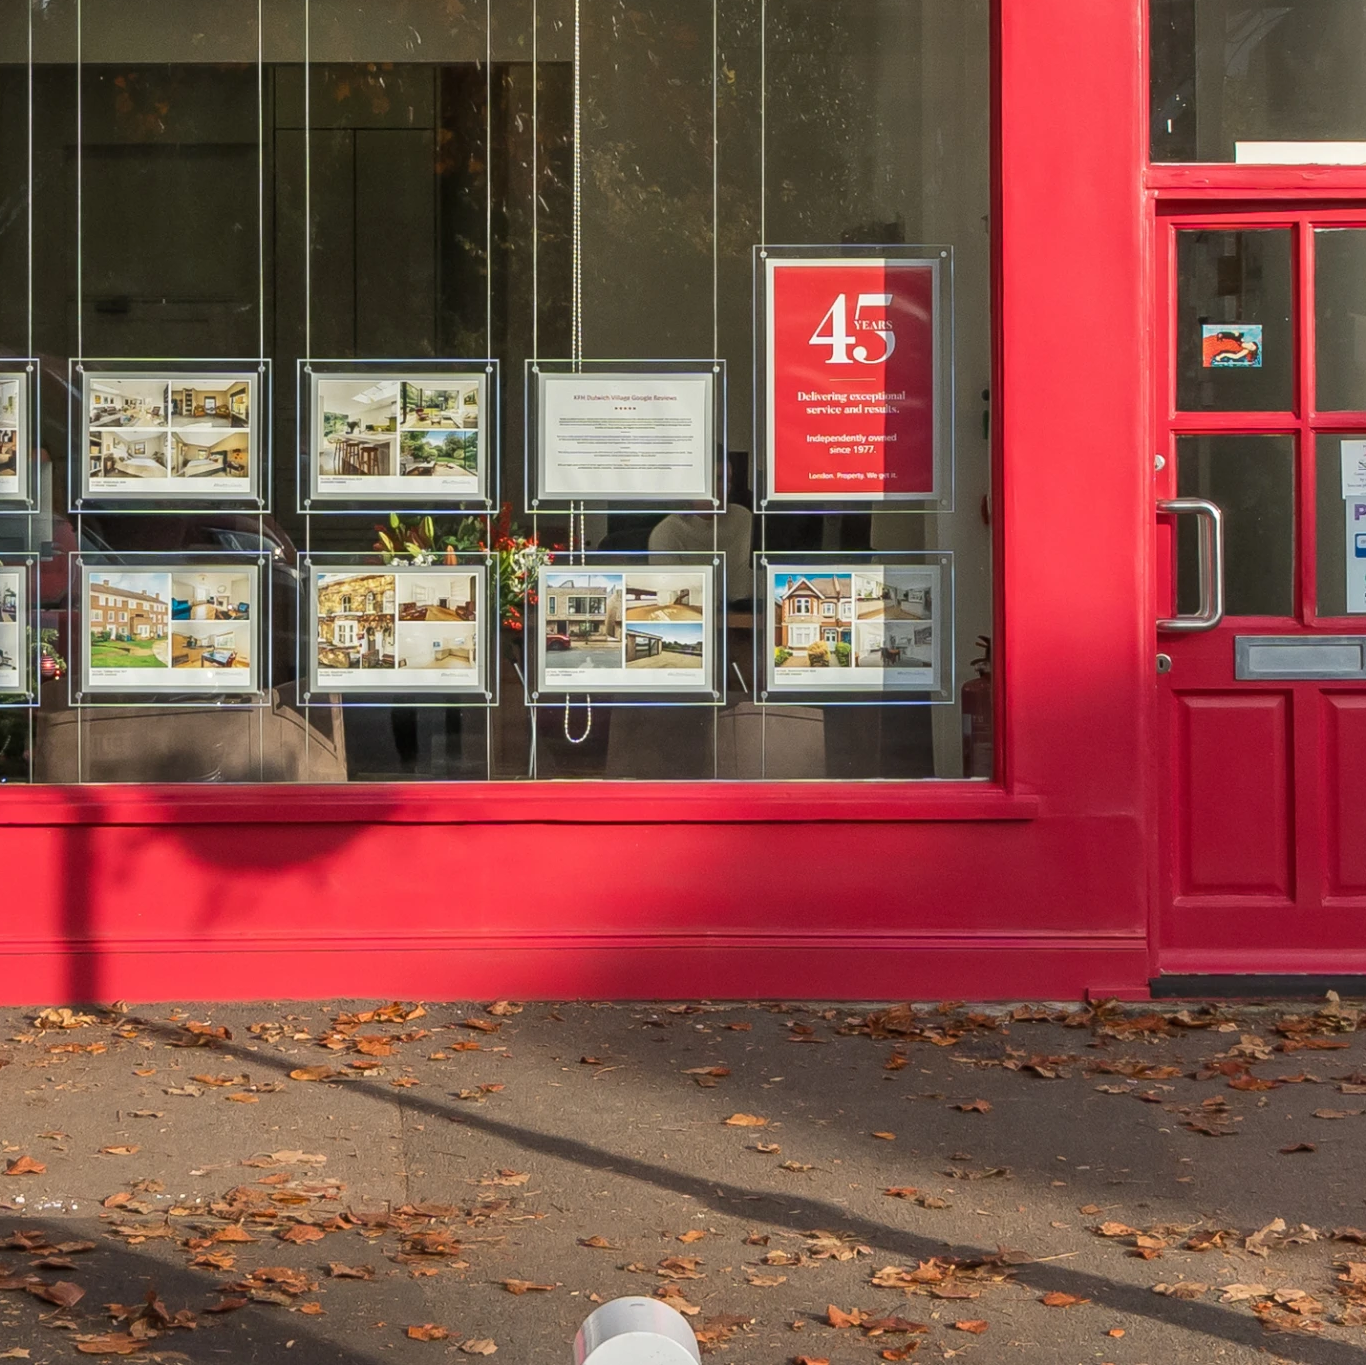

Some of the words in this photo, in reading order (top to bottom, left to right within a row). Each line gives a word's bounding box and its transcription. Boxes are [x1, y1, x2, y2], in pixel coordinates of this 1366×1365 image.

[808, 292, 897, 365] 45
[853, 319, 894, 331] YEARS
[611, 394, 631, 402] Village
[631, 394, 653, 402] Google
[797, 390, 848, 404] Delivering
[849, 390, 906, 404] exceptional
[806, 404, 842, 415] service
[844, 404, 863, 415] and
[864, 404, 900, 415] results.
[806, 433, 867, 444] Independently
[868, 433, 897, 443] owned
[829, 444, 851, 455] since
[853, 444, 877, 455] 1977.
[808, 471, 835, 481] London.
[837, 471, 865, 482] Property.
[866, 471, 878, 480] We
[878, 471, 890, 482] get
